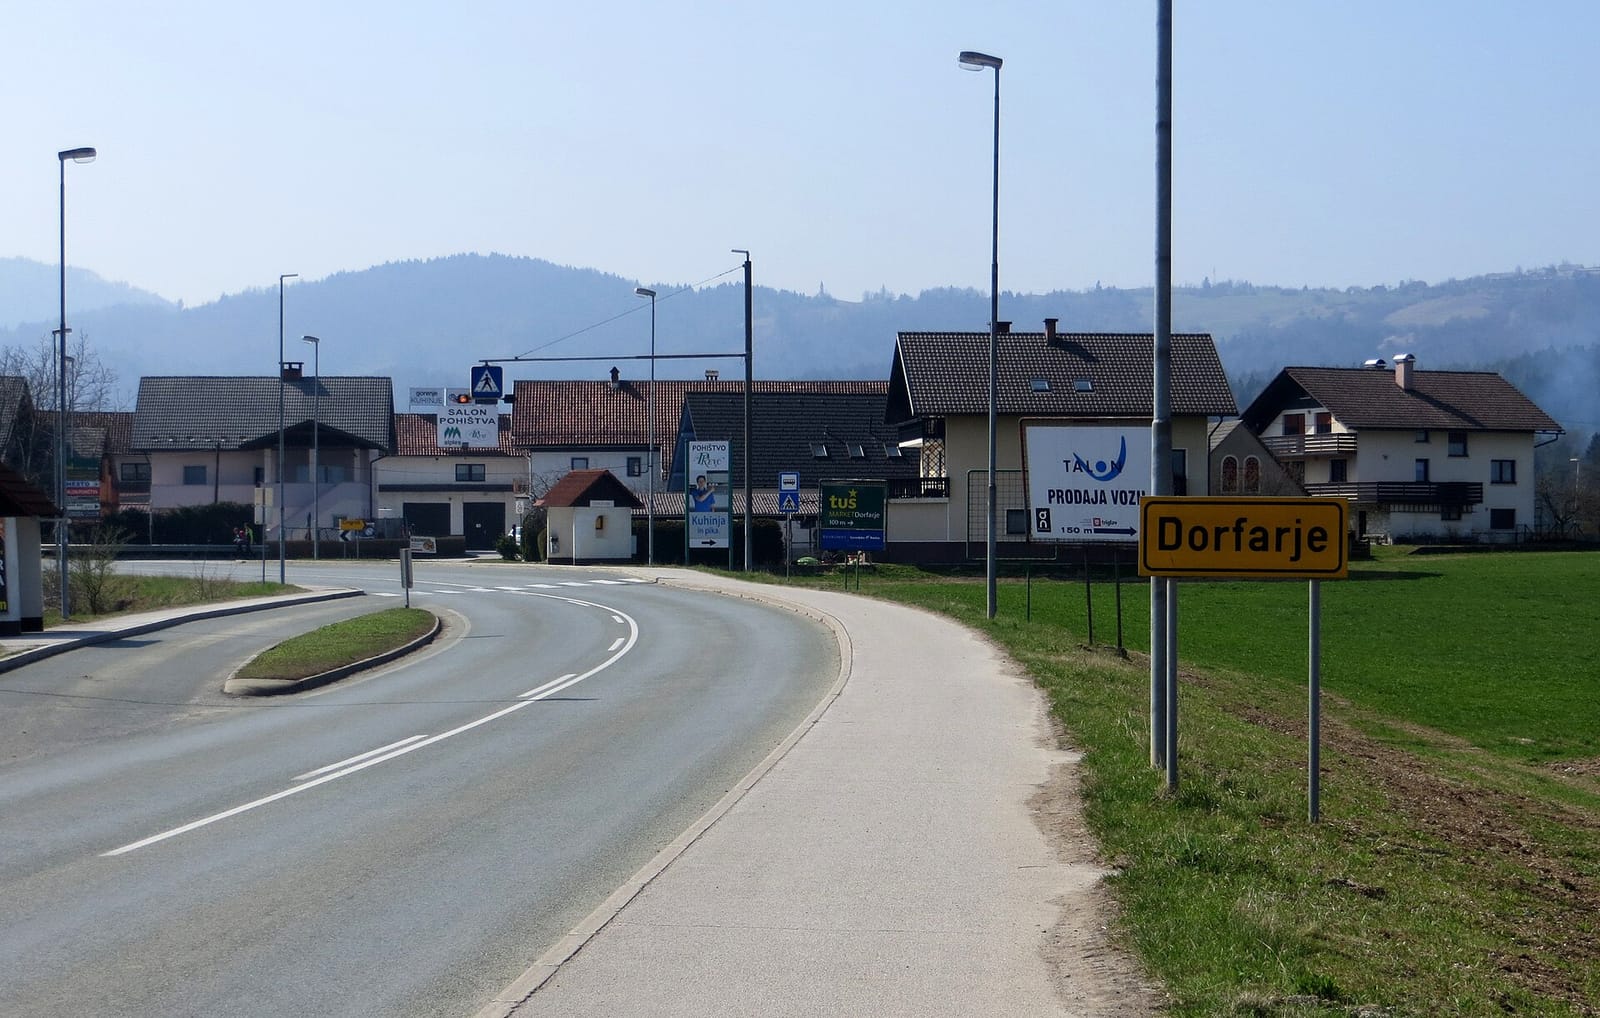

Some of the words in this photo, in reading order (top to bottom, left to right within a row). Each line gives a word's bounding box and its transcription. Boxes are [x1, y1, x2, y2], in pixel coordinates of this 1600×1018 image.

[448, 408, 487, 416] SALON
[439, 416, 496, 425] POHIŠTVA
[692, 443, 726, 452] POHIŠTVO
[1047, 489, 1107, 505] PRODAJA
[691, 515, 726, 528] Kuhinja
[1061, 526, 1080, 534] 150
[1158, 517, 1328, 562] Dorfarje
